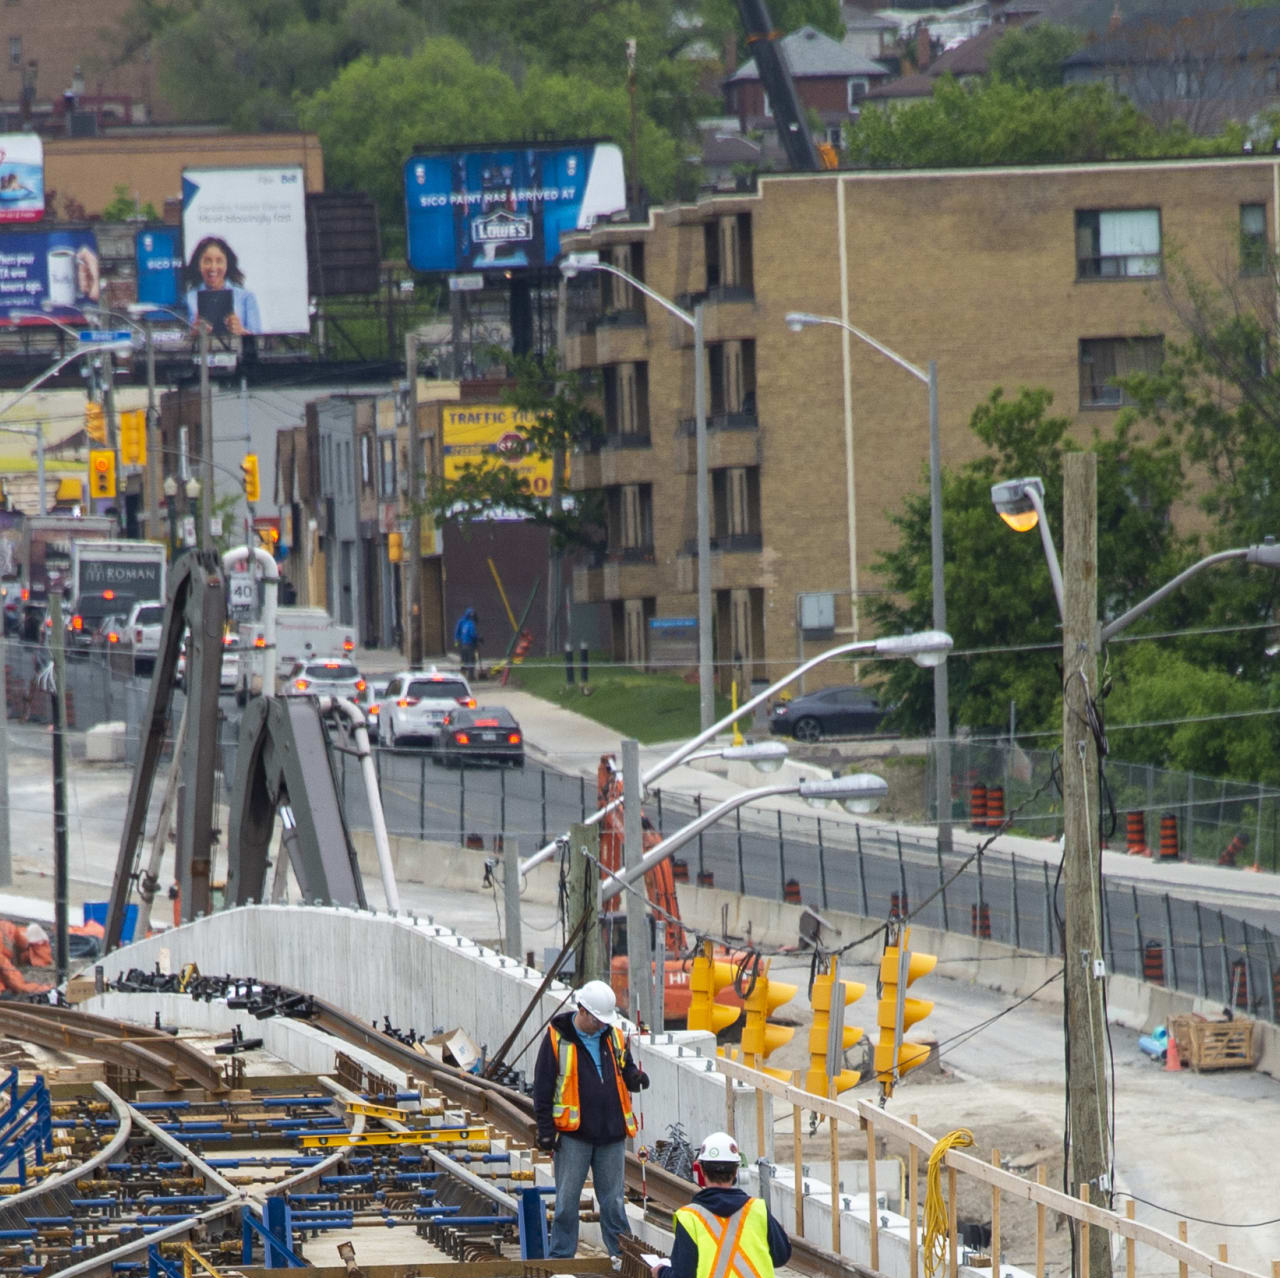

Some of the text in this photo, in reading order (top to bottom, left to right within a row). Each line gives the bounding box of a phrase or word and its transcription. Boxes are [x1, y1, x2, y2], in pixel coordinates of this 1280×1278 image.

[281, 174, 297, 184] Bell
[420, 188, 576, 207] SICO PAINT HAS ARRIVED AT
[478, 223, 527, 239] LOWE'S
[16, 254, 35, 268] your
[147, 258, 170, 270] SICO
[0, 282, 24, 293] hours
[26, 283, 43, 295] ago.
[449, 412, 507, 425] TRAFFIC
[106, 567, 156, 581] ROMAN
[233, 584, 252, 599] 40
